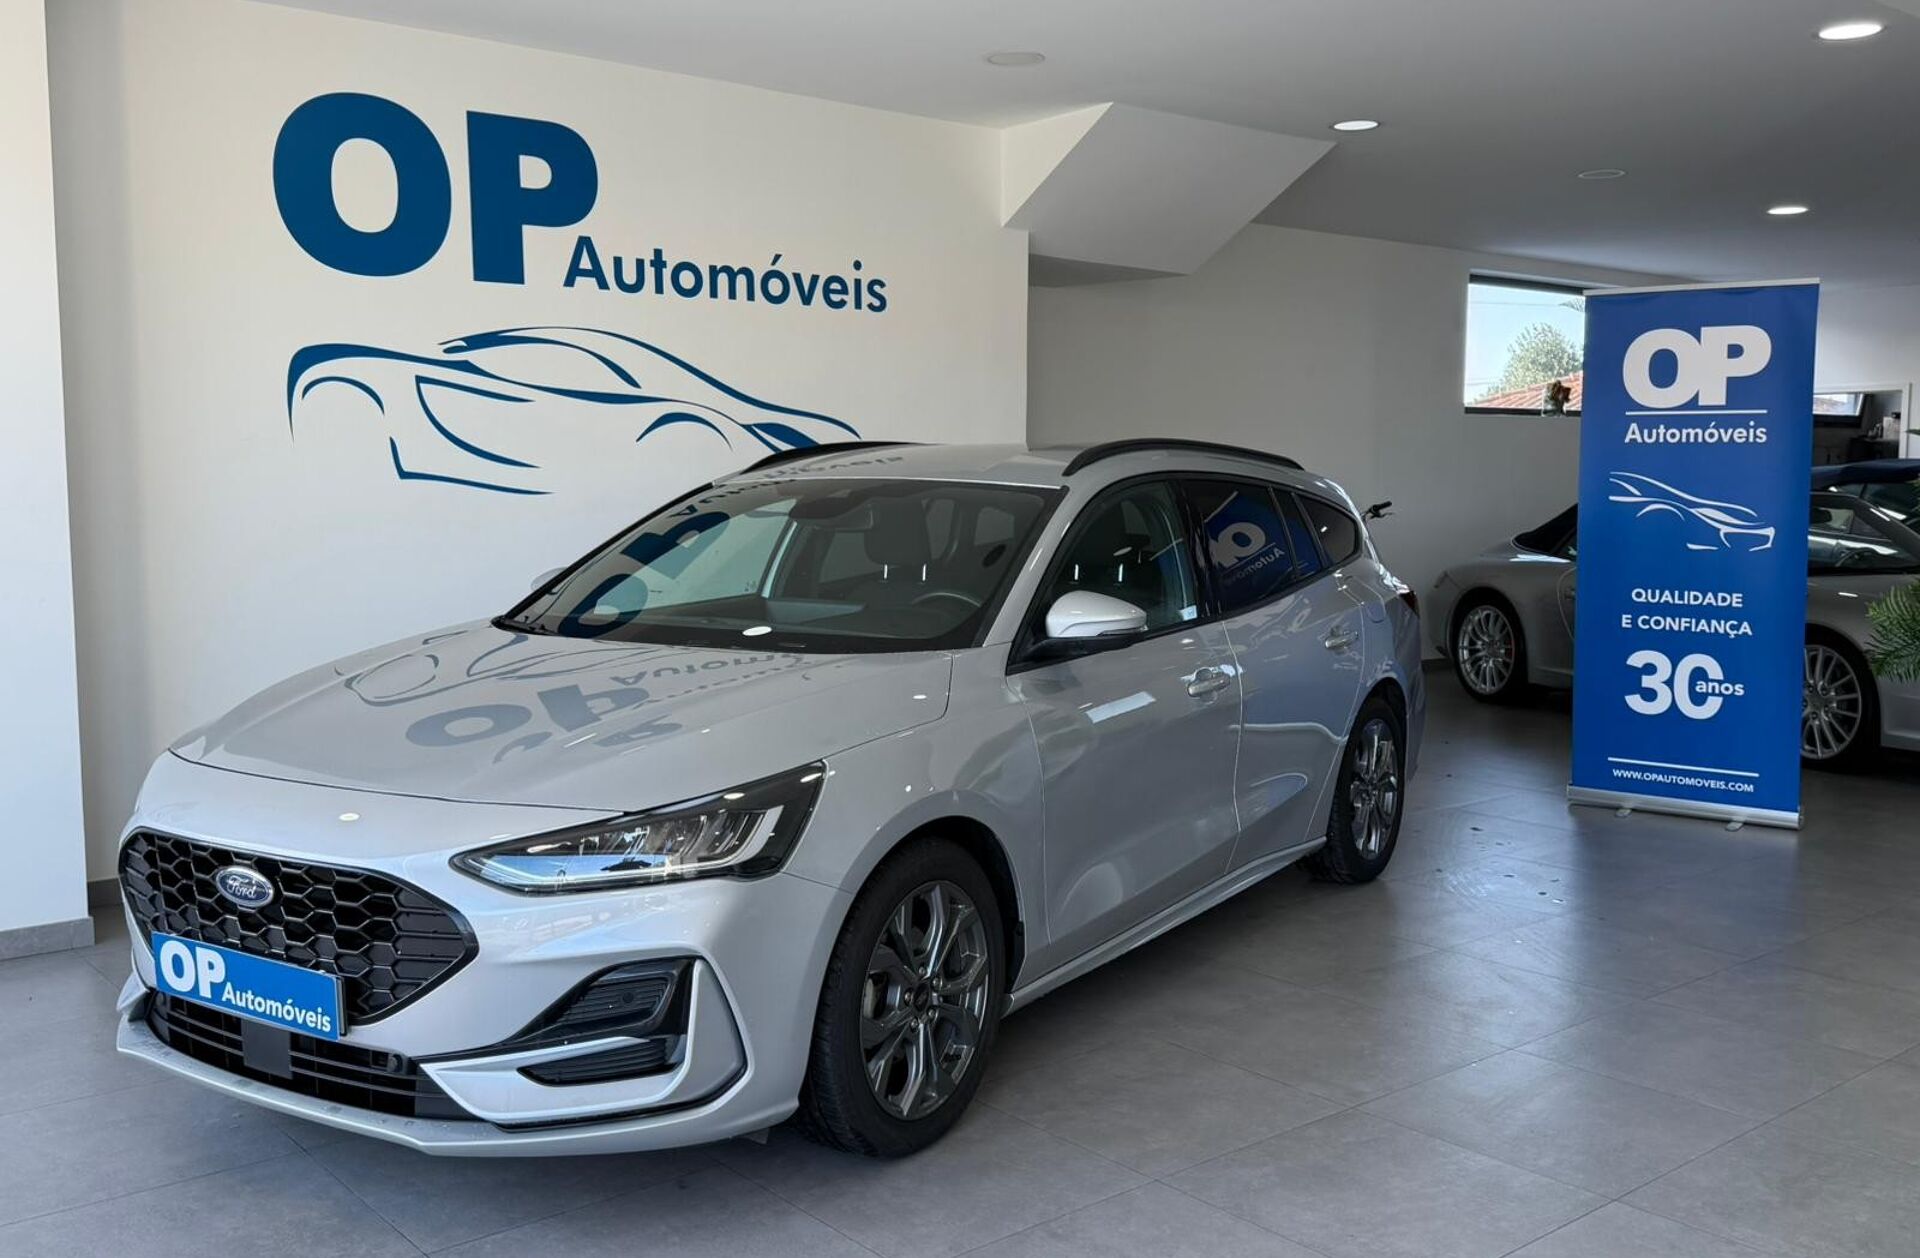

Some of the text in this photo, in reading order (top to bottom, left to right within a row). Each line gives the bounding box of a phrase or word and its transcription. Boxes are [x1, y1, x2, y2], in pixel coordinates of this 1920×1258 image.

[273, 91, 888, 314] OP Automóveis
[1623, 325, 1772, 409] OP
[1624, 420, 1768, 444] Automóveis
[1631, 588, 1744, 608] QUALIDADE
[1621, 614, 1753, 639] E CONFIANÇA
[1624, 650, 1746, 720] 30 anos
[1612, 768, 1755, 793] WWW.OPAUTOMOVEIS.COM
[226, 874, 258, 899] Ford
[160, 940, 331, 1033] OP Automóveis
